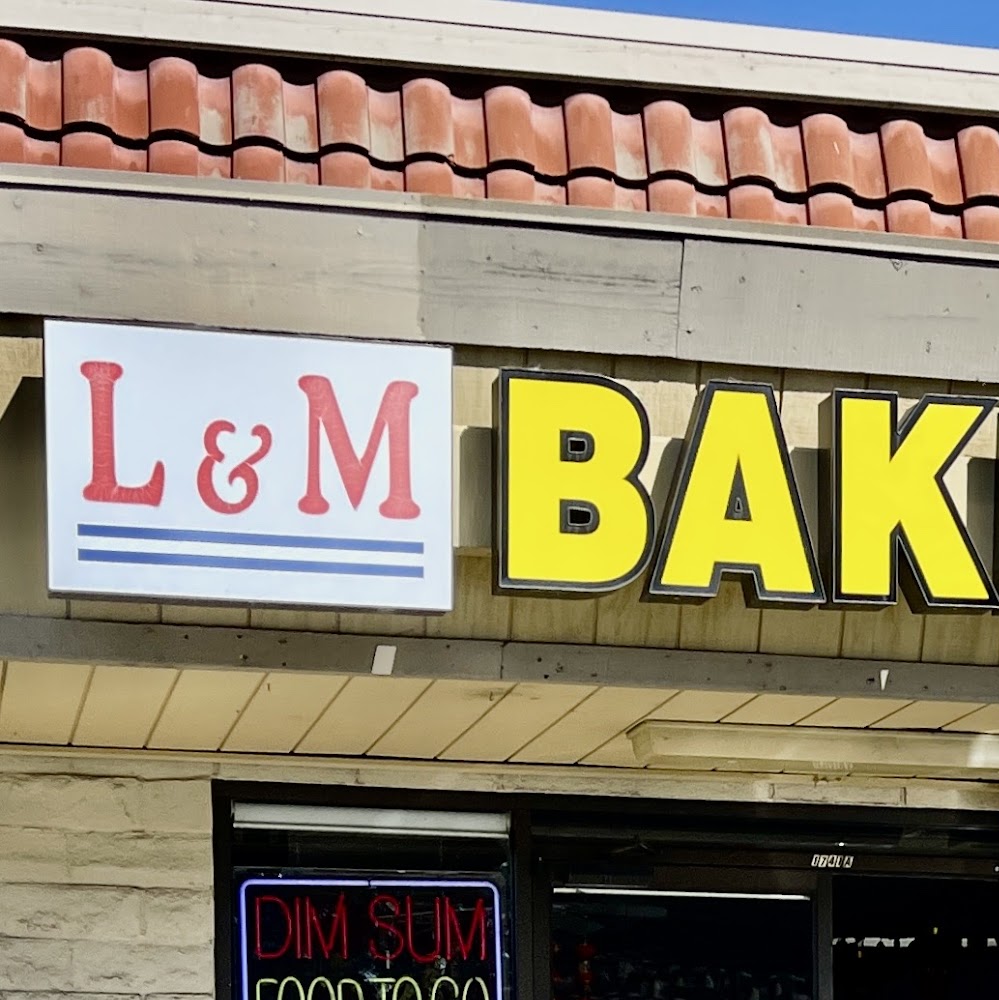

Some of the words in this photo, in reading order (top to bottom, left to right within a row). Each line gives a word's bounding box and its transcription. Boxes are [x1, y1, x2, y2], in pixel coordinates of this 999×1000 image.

[80, 359, 166, 508] L
[196, 418, 273, 516] &
[297, 374, 421, 521] M
[254, 891, 348, 961] DIM
[368, 893, 489, 964] SUM
